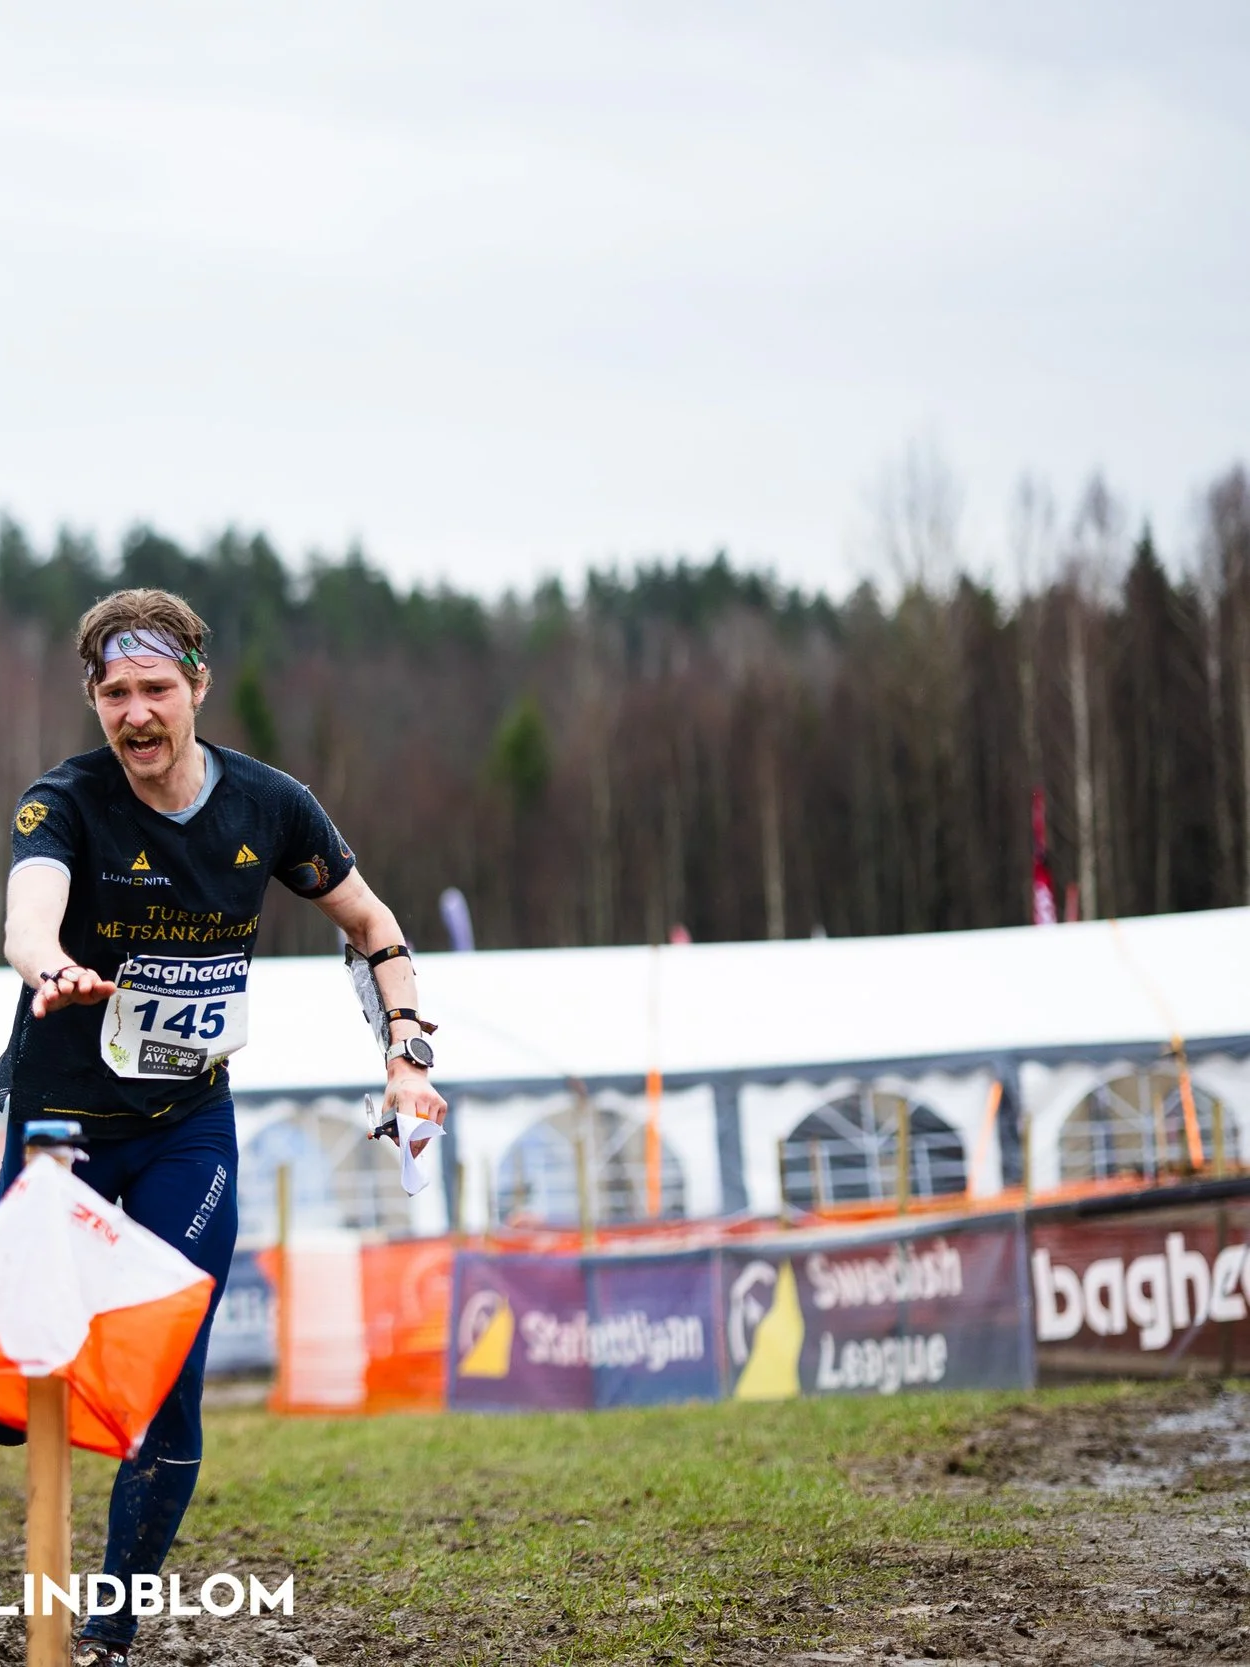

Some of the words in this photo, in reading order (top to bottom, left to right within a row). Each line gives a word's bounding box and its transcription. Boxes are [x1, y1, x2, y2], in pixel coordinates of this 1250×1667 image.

[146, 905, 223, 924] TURUN
[123, 961, 248, 984] bagheera
[132, 982, 200, 997] KOLMÅRDSMEDELN
[221, 985, 236, 993] 2026
[133, 1000, 227, 1040] 145
[146, 1045, 201, 1060] GODKÄNDA
[184, 1164, 227, 1244] noname
[807, 1238, 963, 1310] Swedish
[1031, 1231, 1250, 1351] baghe
[817, 1332, 948, 1394] League
